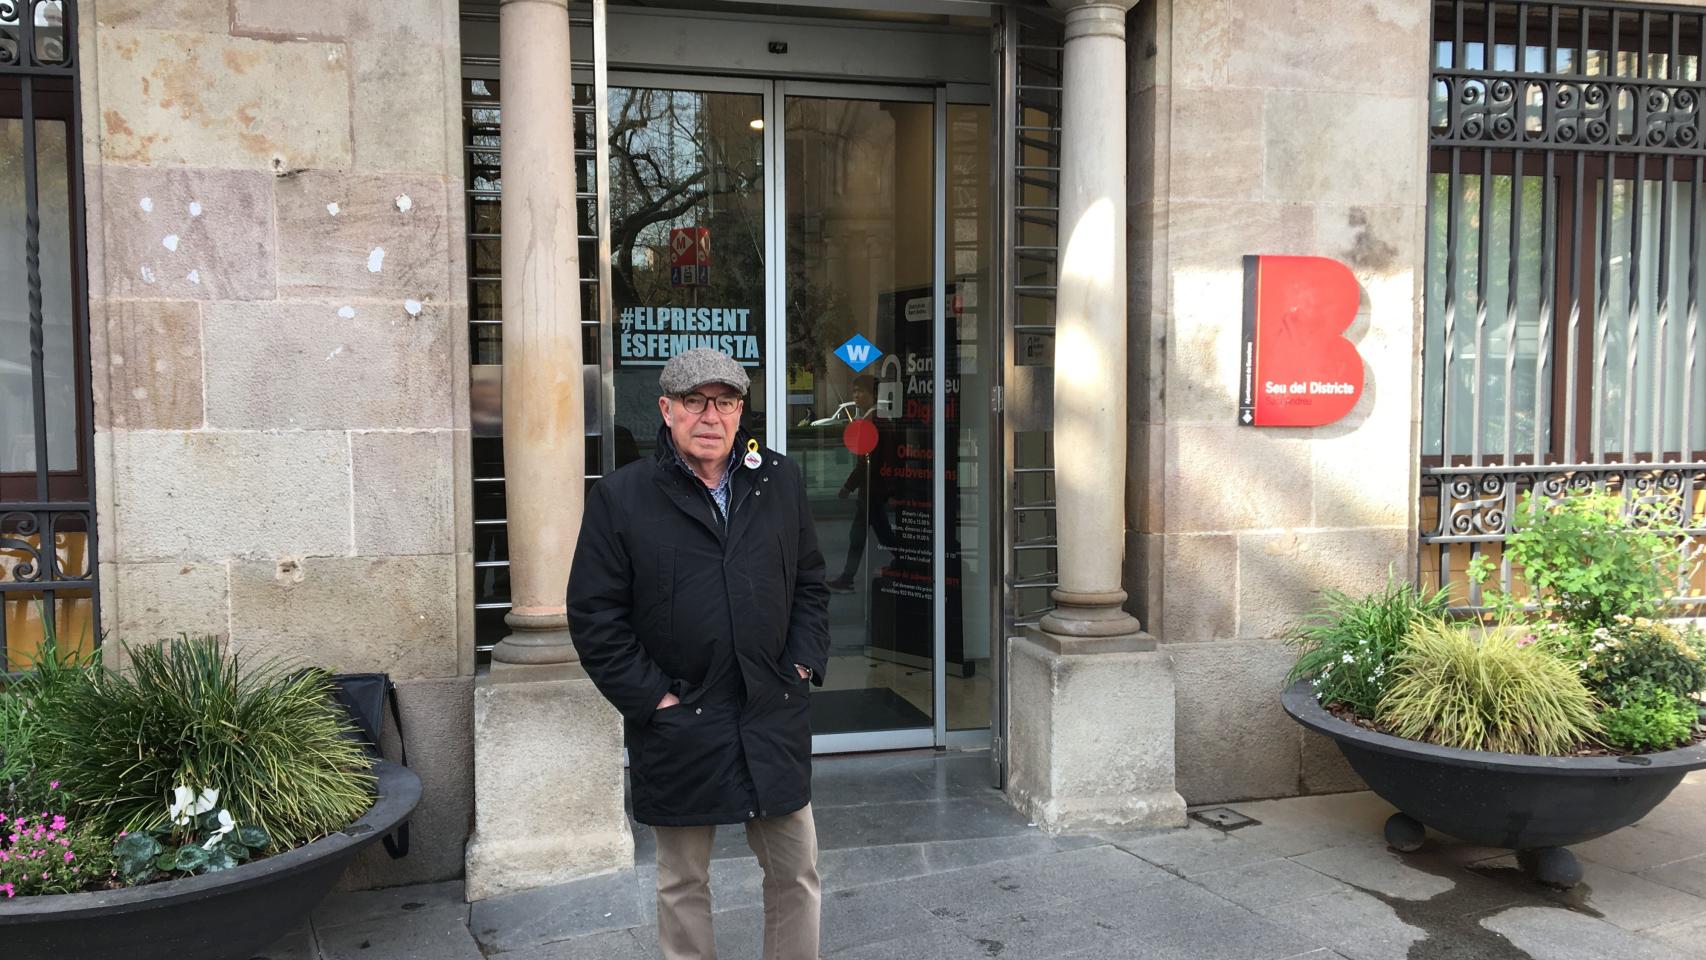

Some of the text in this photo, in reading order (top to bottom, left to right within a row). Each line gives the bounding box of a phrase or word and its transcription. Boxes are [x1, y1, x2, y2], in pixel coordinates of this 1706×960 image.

[620, 306, 750, 332] #ELPRESENT
[846, 344, 871, 362] W
[907, 352, 934, 373] San
[1265, 381, 1355, 394] Seu del Districte
